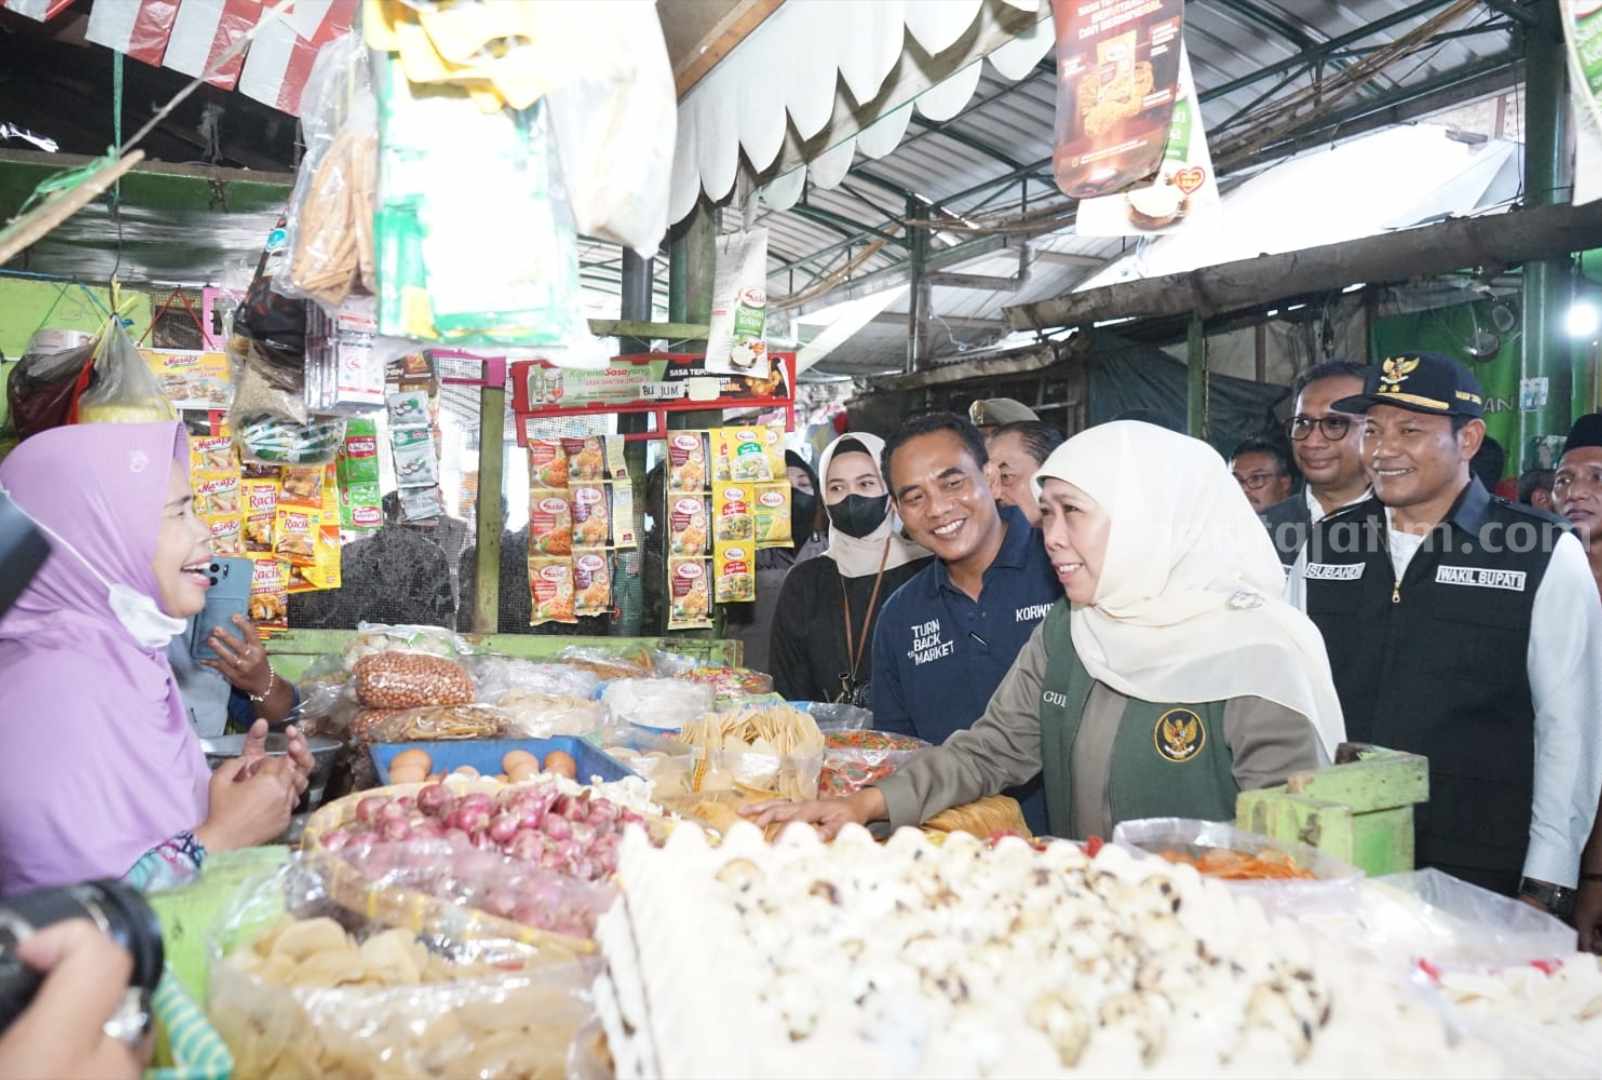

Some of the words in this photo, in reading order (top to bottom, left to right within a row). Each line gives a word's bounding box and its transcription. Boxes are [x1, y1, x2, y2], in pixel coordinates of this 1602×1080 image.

[670, 368, 689, 377] SASA
[690, 368, 711, 376] TEP
[660, 385, 679, 396] JUM
[1438, 567, 1476, 583] WAKIL
[1478, 571, 1522, 588] BUPATI
[911, 618, 940, 638] TURN
[913, 634, 942, 652] BACK
[914, 640, 954, 666] MARKET
